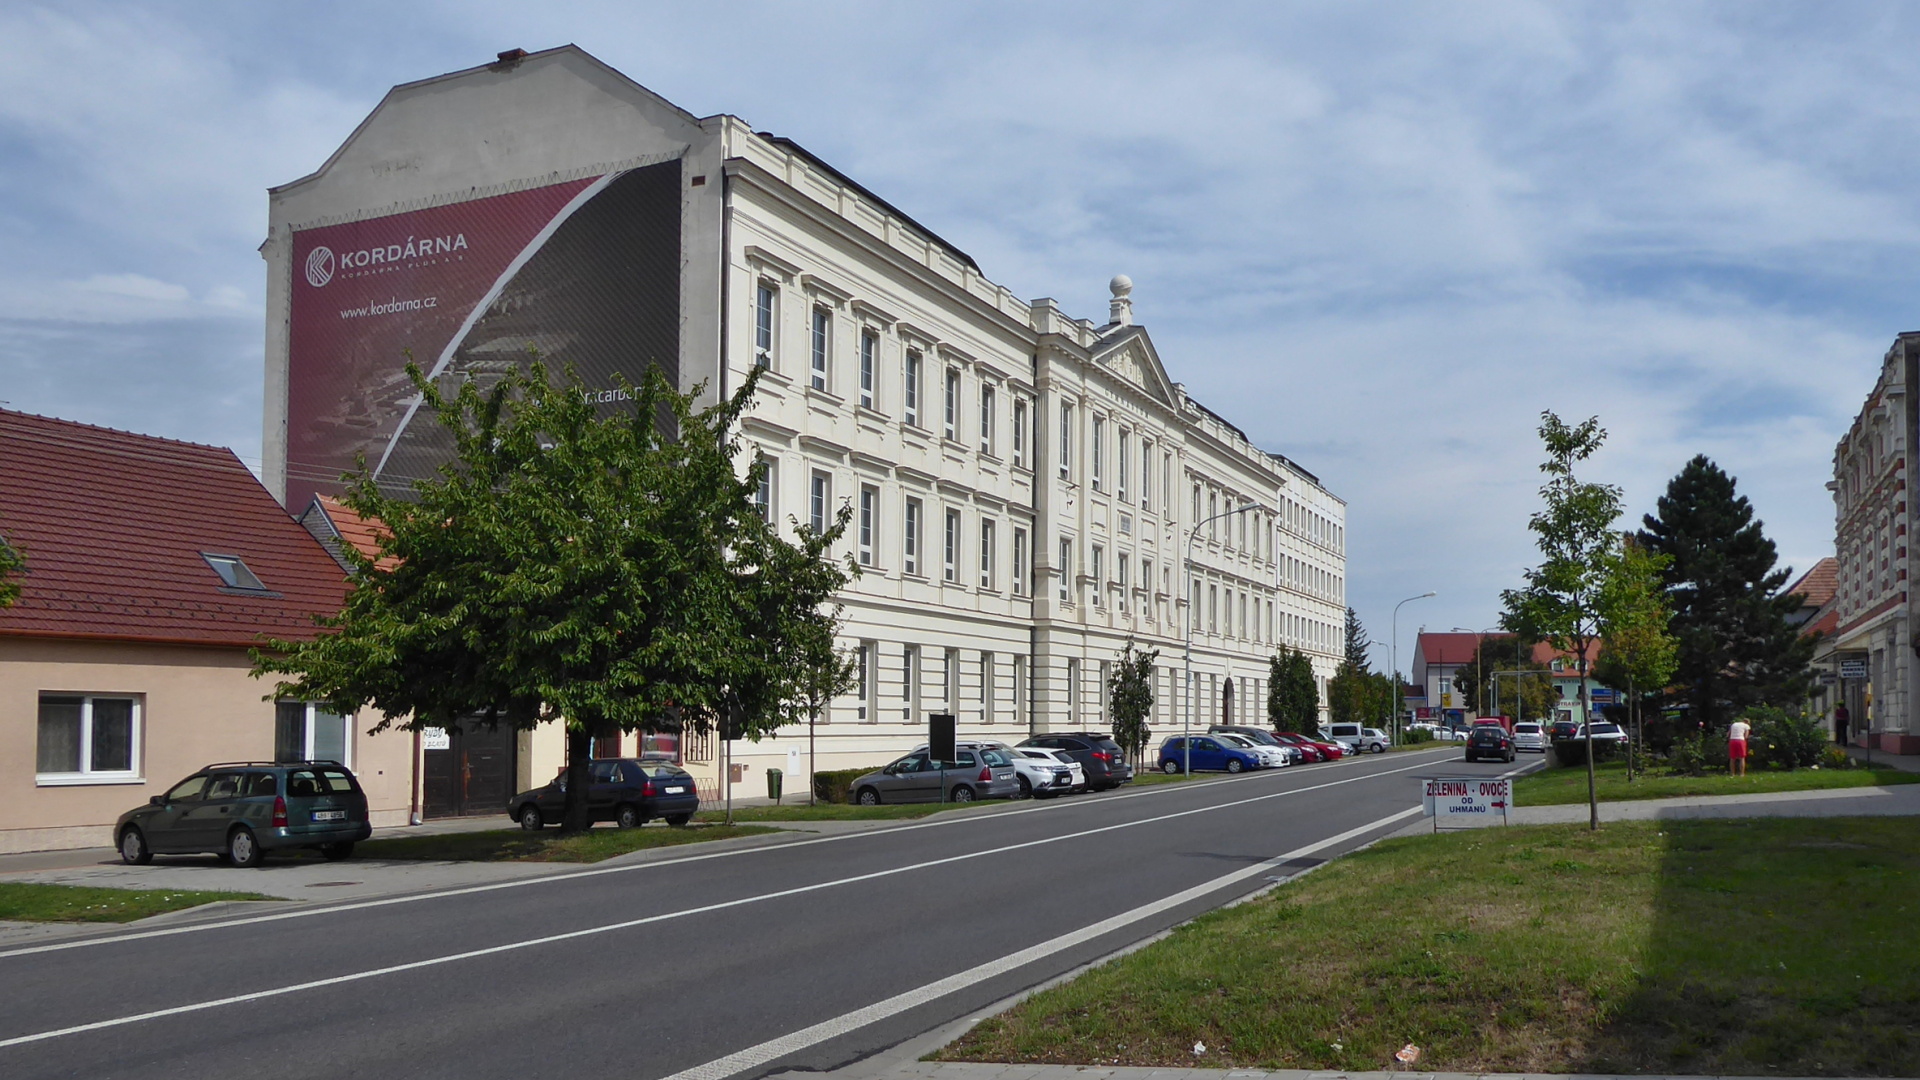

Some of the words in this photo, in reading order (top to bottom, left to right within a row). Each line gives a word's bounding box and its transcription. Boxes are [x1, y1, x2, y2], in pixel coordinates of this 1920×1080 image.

[341, 233, 468, 269] KORDÁRNA
[340, 296, 437, 320] www.kordarna.cz
[1426, 782, 1468, 796] ZELENINA
[1479, 782, 1508, 796] OVOCE
[1449, 804, 1486, 813] UHMANŮ
